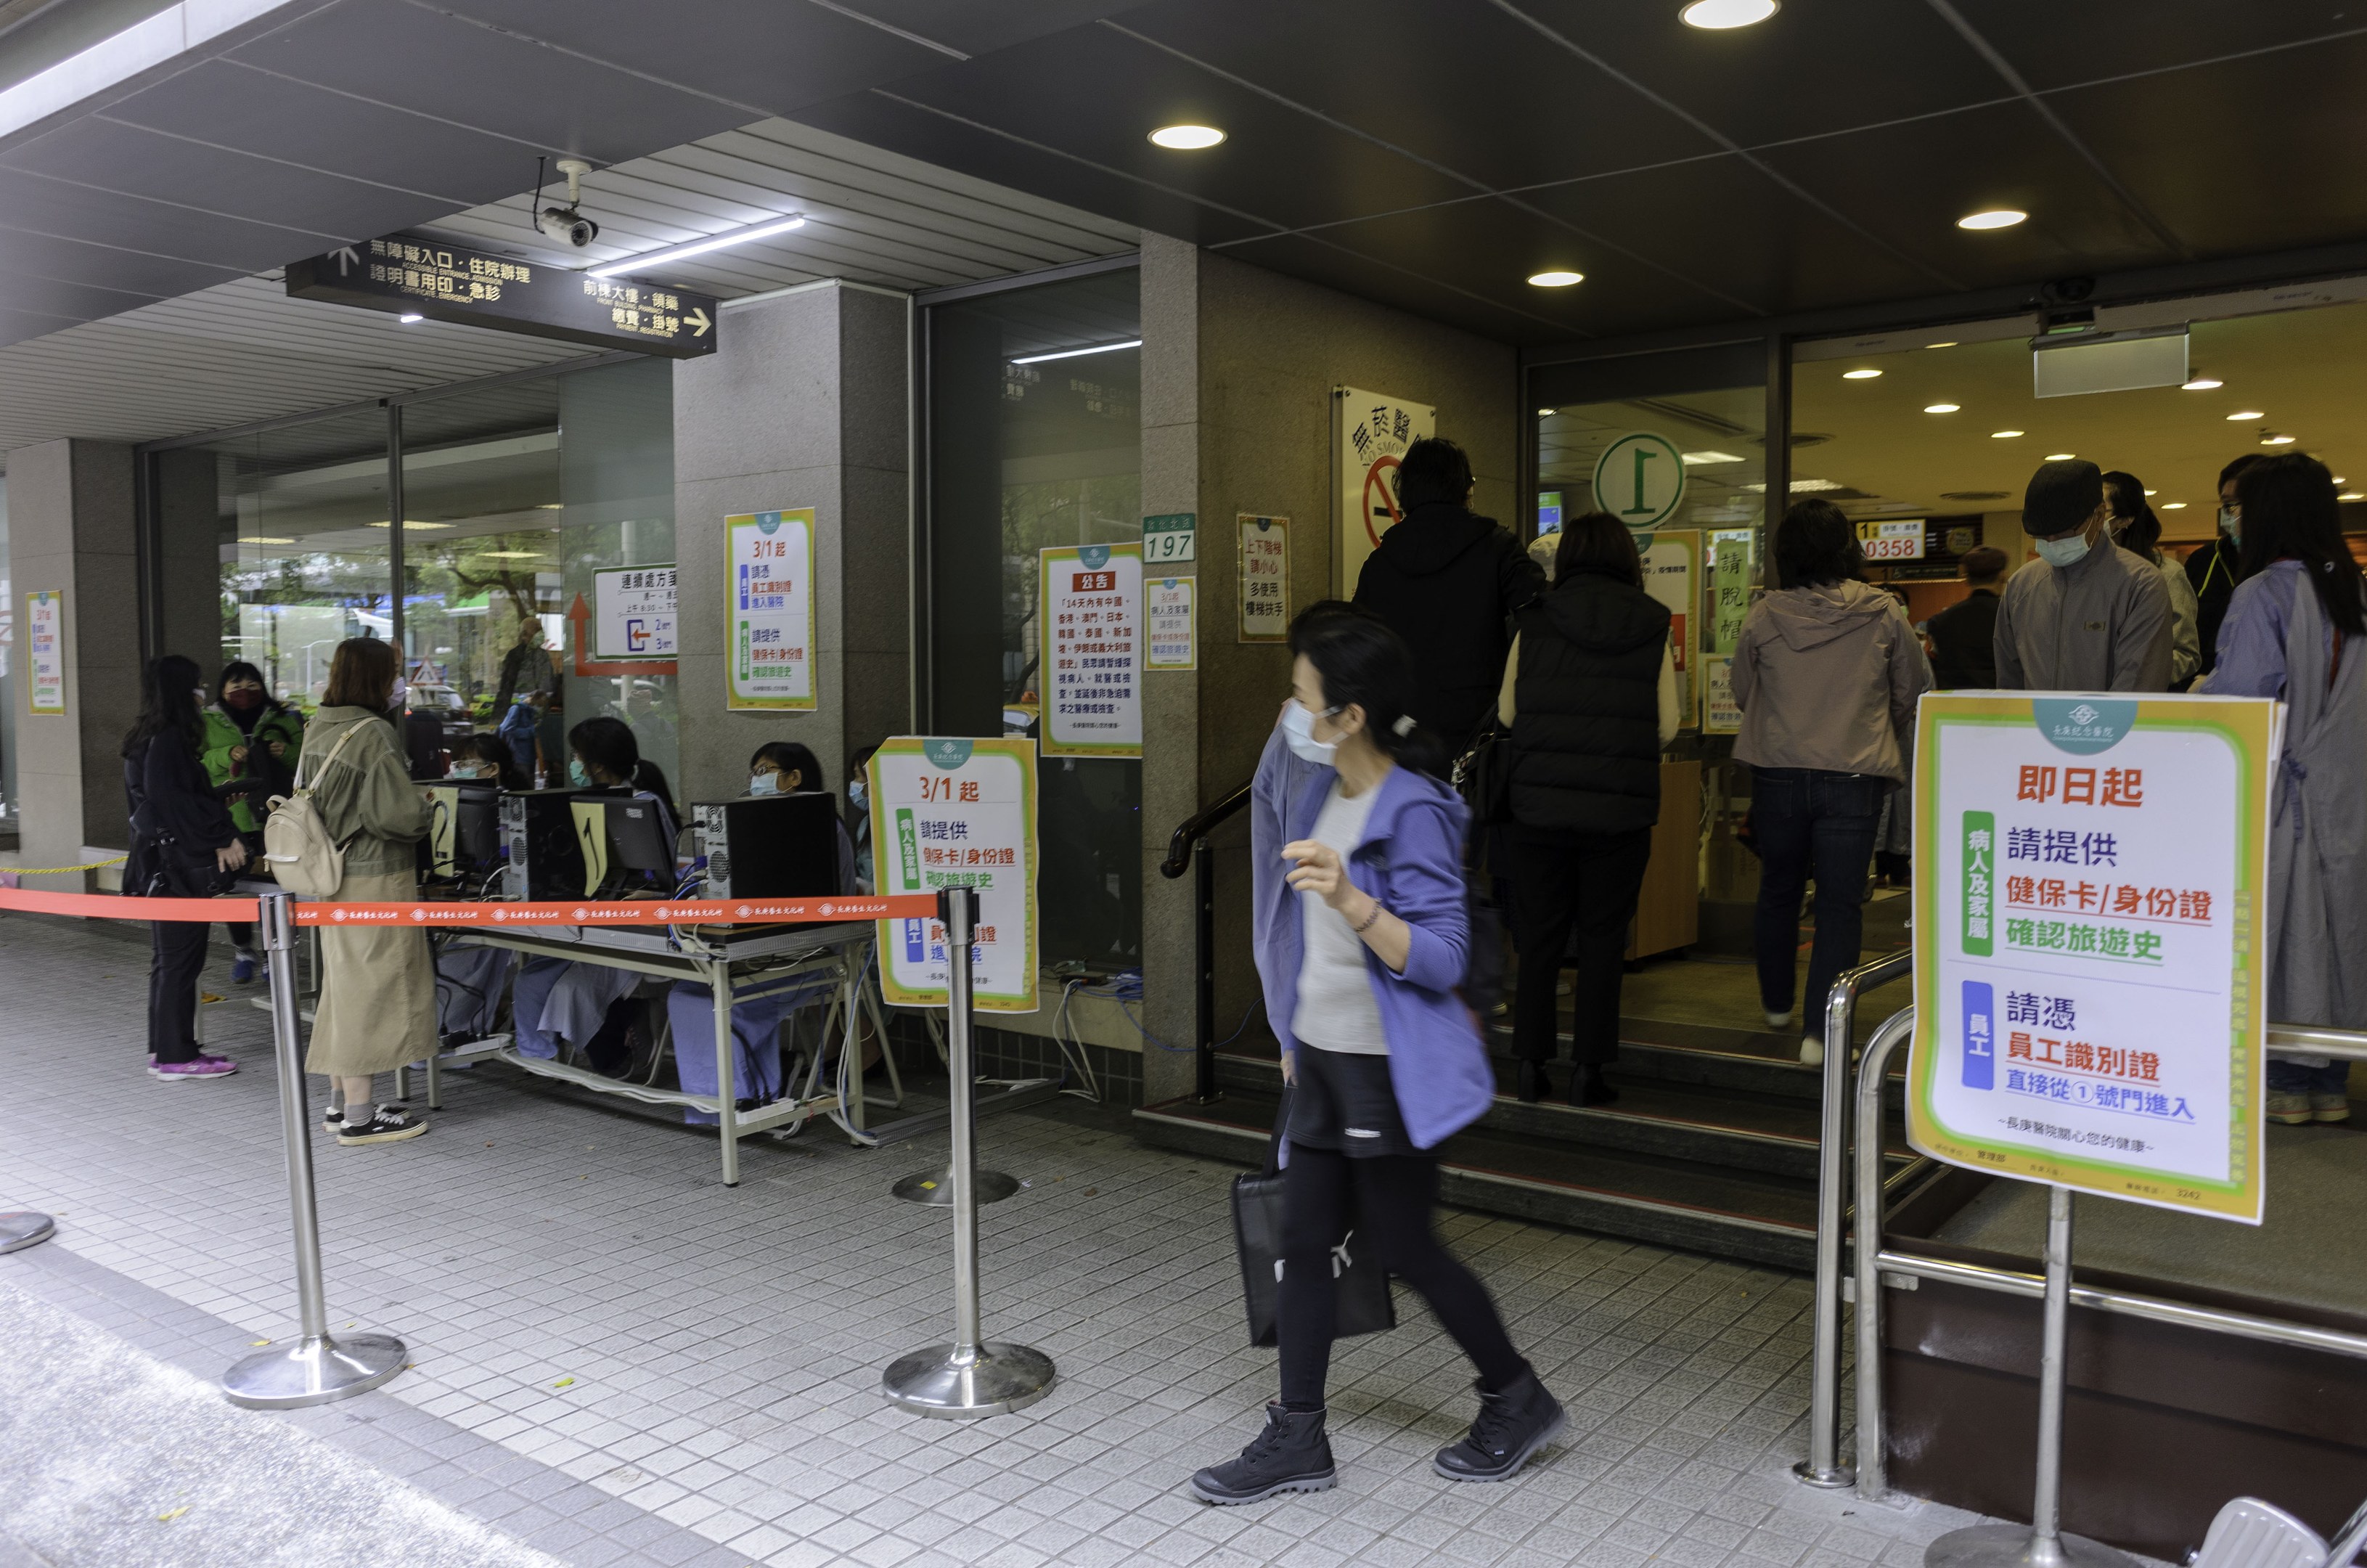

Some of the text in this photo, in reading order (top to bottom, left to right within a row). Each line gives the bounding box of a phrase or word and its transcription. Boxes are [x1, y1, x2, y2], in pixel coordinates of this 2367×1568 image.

[1352, 405, 1421, 457] 無菸醫
[1148, 535, 1191, 558] 197
[1865, 539, 1915, 558] 0358
[1082, 573, 1108, 589] 公告
[1250, 581, 1278, 597] 多使用
[919, 776, 980, 803] 3/1 起
[2016, 765, 2143, 807] 即日起
[920, 820, 968, 841] 請提供
[2007, 826, 2118, 867] 請提供
[1967, 829, 1990, 939] 病人及家屬
[2006, 875, 2212, 920] 健保卡/身份證
[2006, 918, 2164, 960] 確認旅遊史
[2006, 990, 2076, 1031] 請憑
[1969, 1013, 1990, 1057] 員工
[2006, 1031, 2161, 1082] 員工識別證
[2176, 1188, 2202, 1200] 3242
